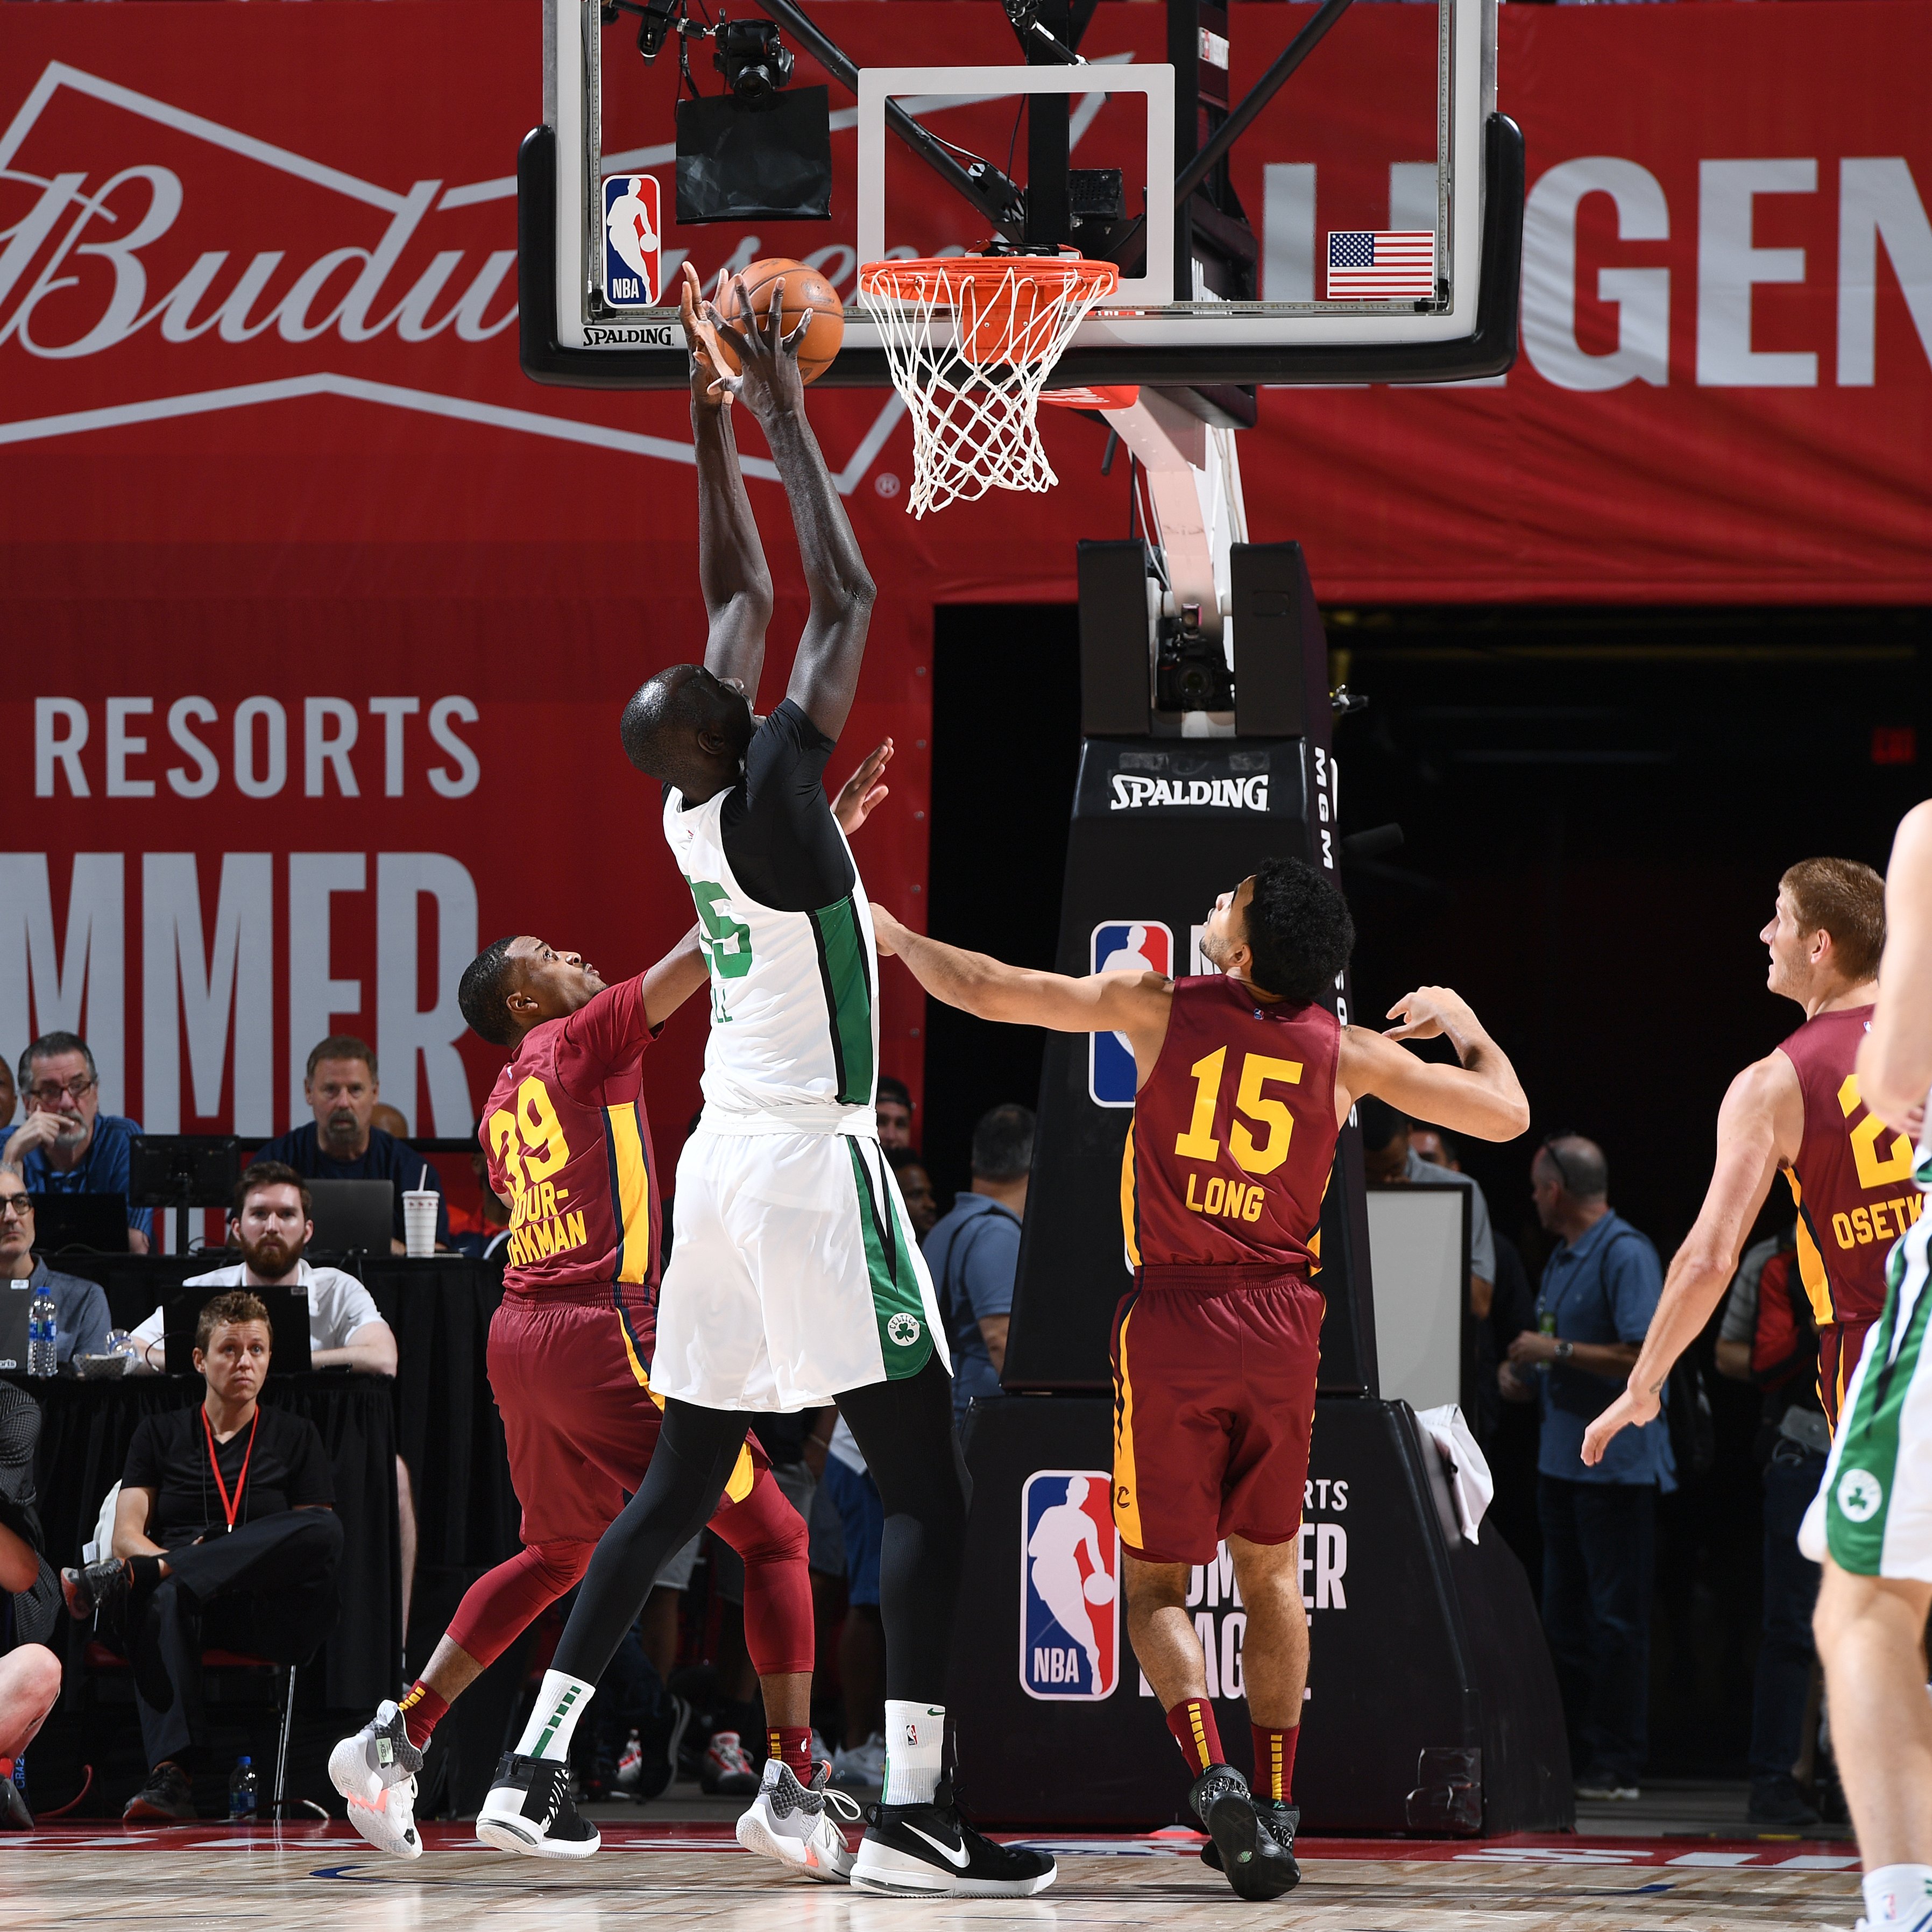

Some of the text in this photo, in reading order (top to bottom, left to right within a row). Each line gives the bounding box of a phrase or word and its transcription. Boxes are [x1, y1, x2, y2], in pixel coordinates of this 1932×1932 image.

[612, 278, 639, 299] NBA
[583, 326, 671, 346] SPALDING
[34, 696, 480, 798] RESORTS
[1111, 774, 1270, 811] SPALDING
[1314, 746, 1334, 869] MGM
[1174, 1045, 1304, 1175] 15
[489, 1075, 570, 1201] 39
[1185, 1173, 1265, 1222] LONG
[506, 1210, 588, 1268] HKMAN
[889, 1315, 917, 1329] CELTICS
[1034, 1647, 1079, 1683] NBA
